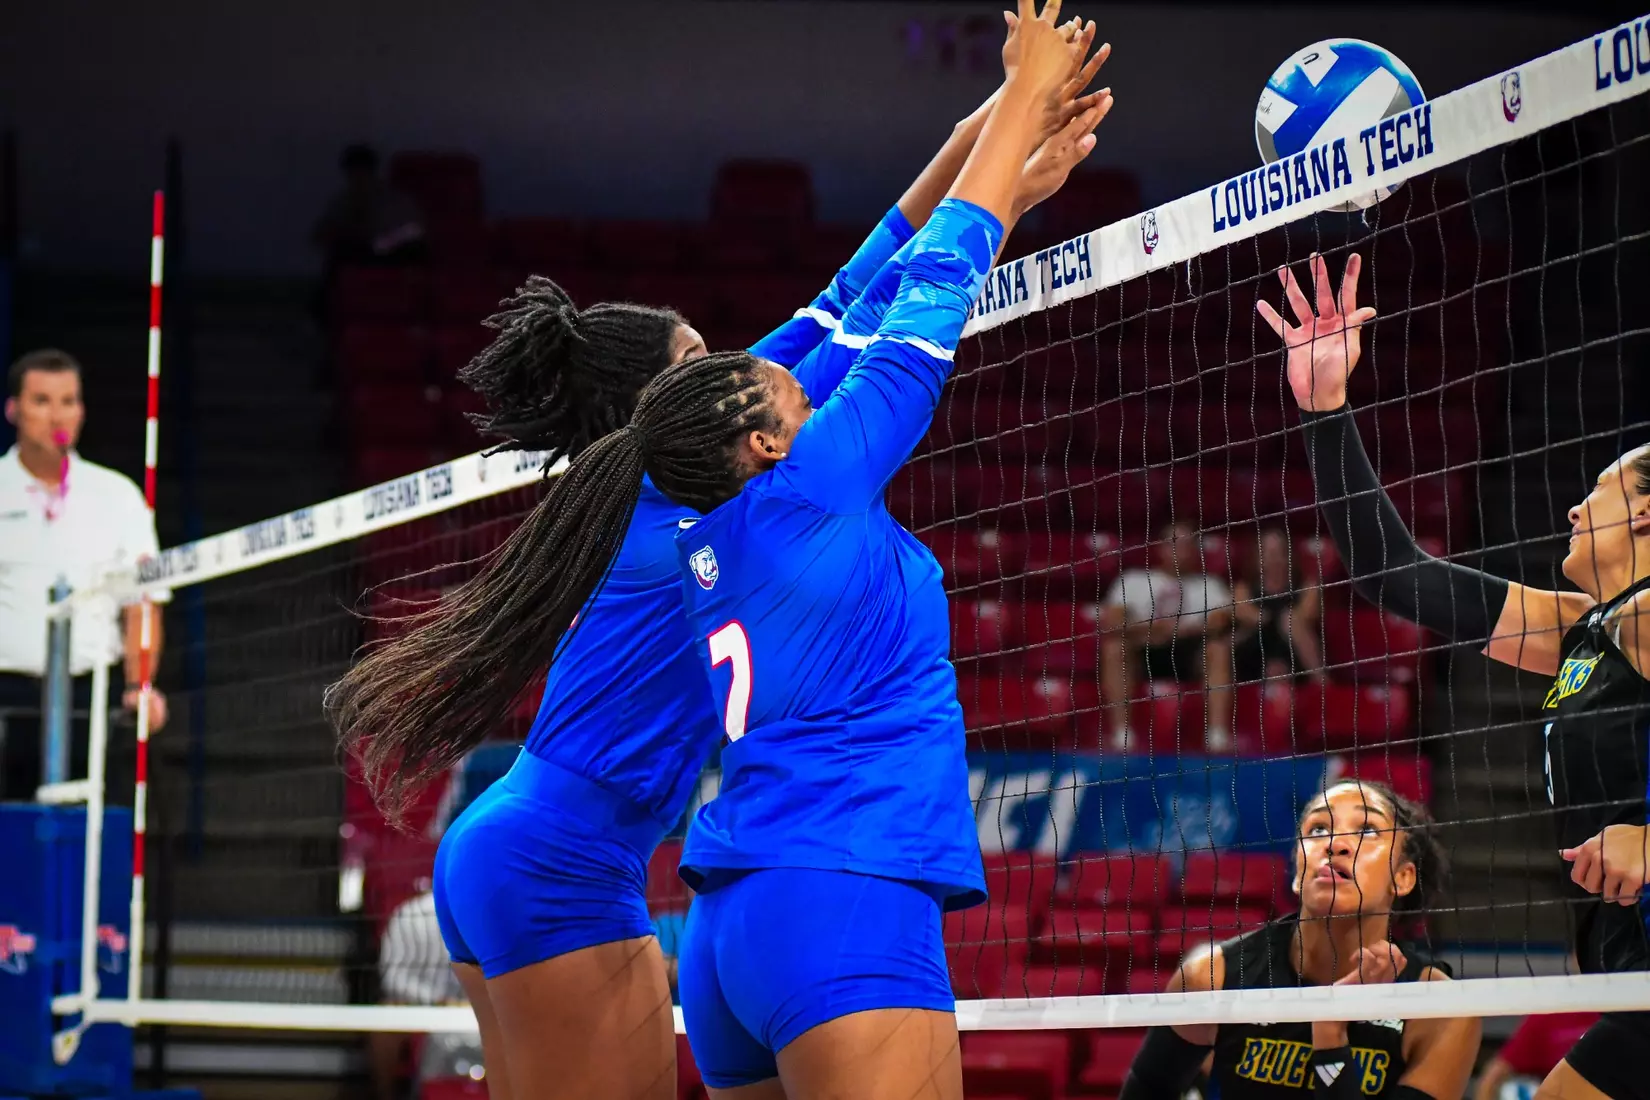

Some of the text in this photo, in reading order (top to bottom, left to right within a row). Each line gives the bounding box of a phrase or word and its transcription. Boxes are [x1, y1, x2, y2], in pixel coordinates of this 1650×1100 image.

[1211, 103, 1434, 233] LOUISIANA TECH
[1036, 234, 1092, 294] TECH
[706, 618, 753, 742] 7
[1235, 1037, 1315, 1088] BLUE
